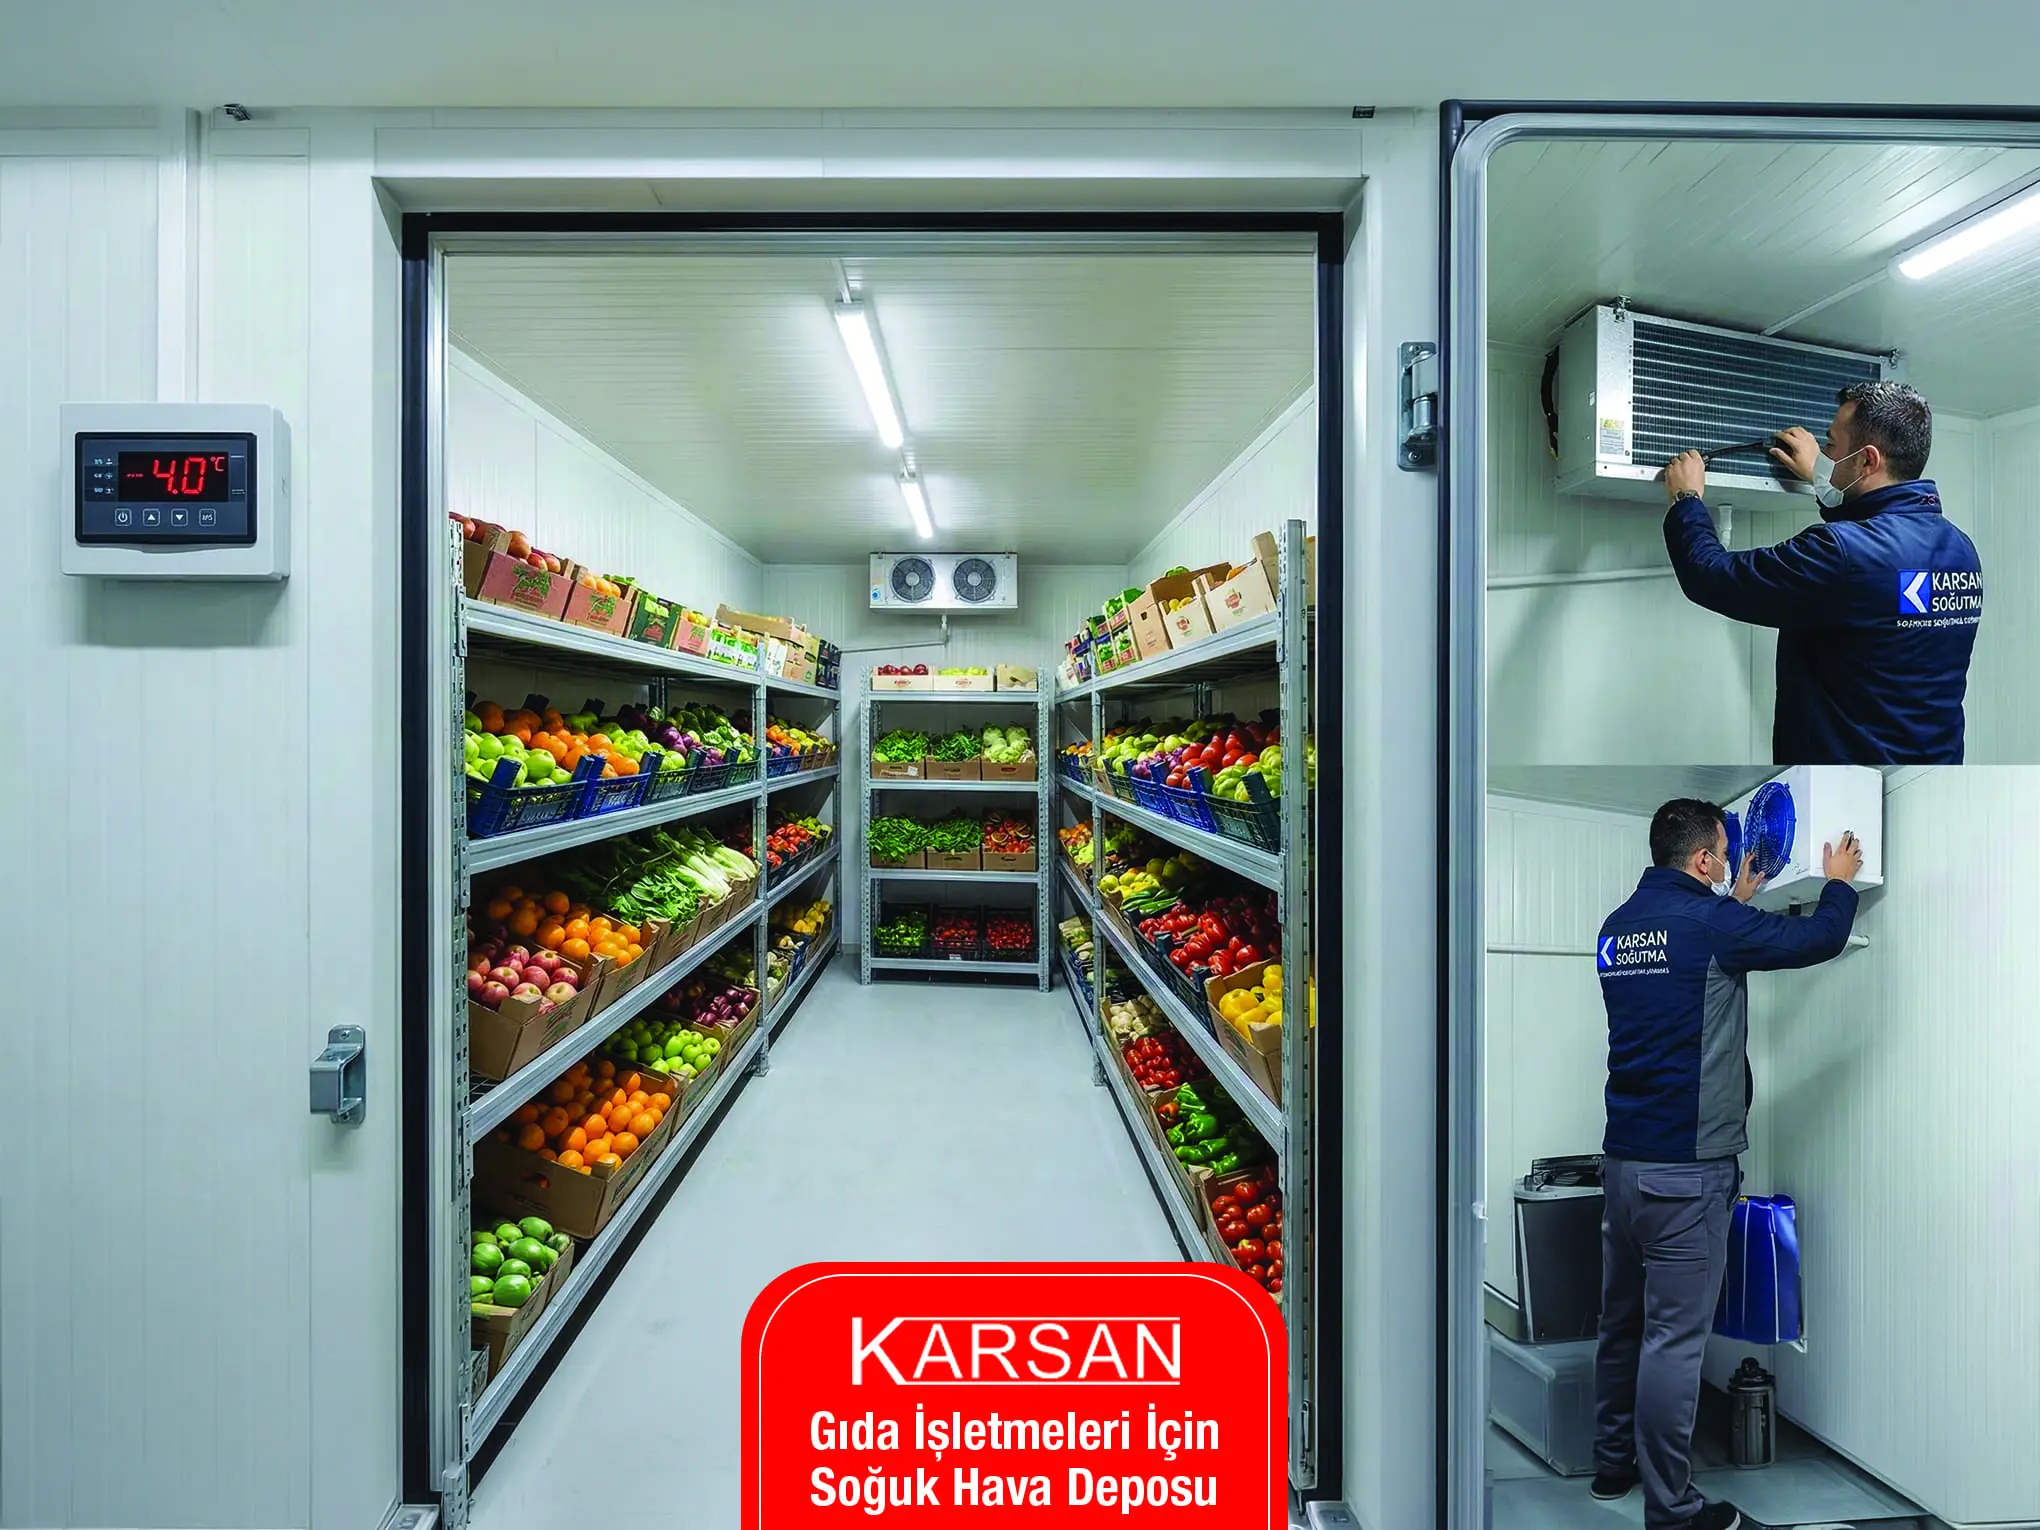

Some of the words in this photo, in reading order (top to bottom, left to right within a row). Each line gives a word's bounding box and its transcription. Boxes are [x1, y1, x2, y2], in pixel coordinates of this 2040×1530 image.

[1932, 572, 1982, 591] KARSAN
[1616, 930, 1668, 950] KARSAN
[1616, 949, 1668, 966] SOĞUTMA
